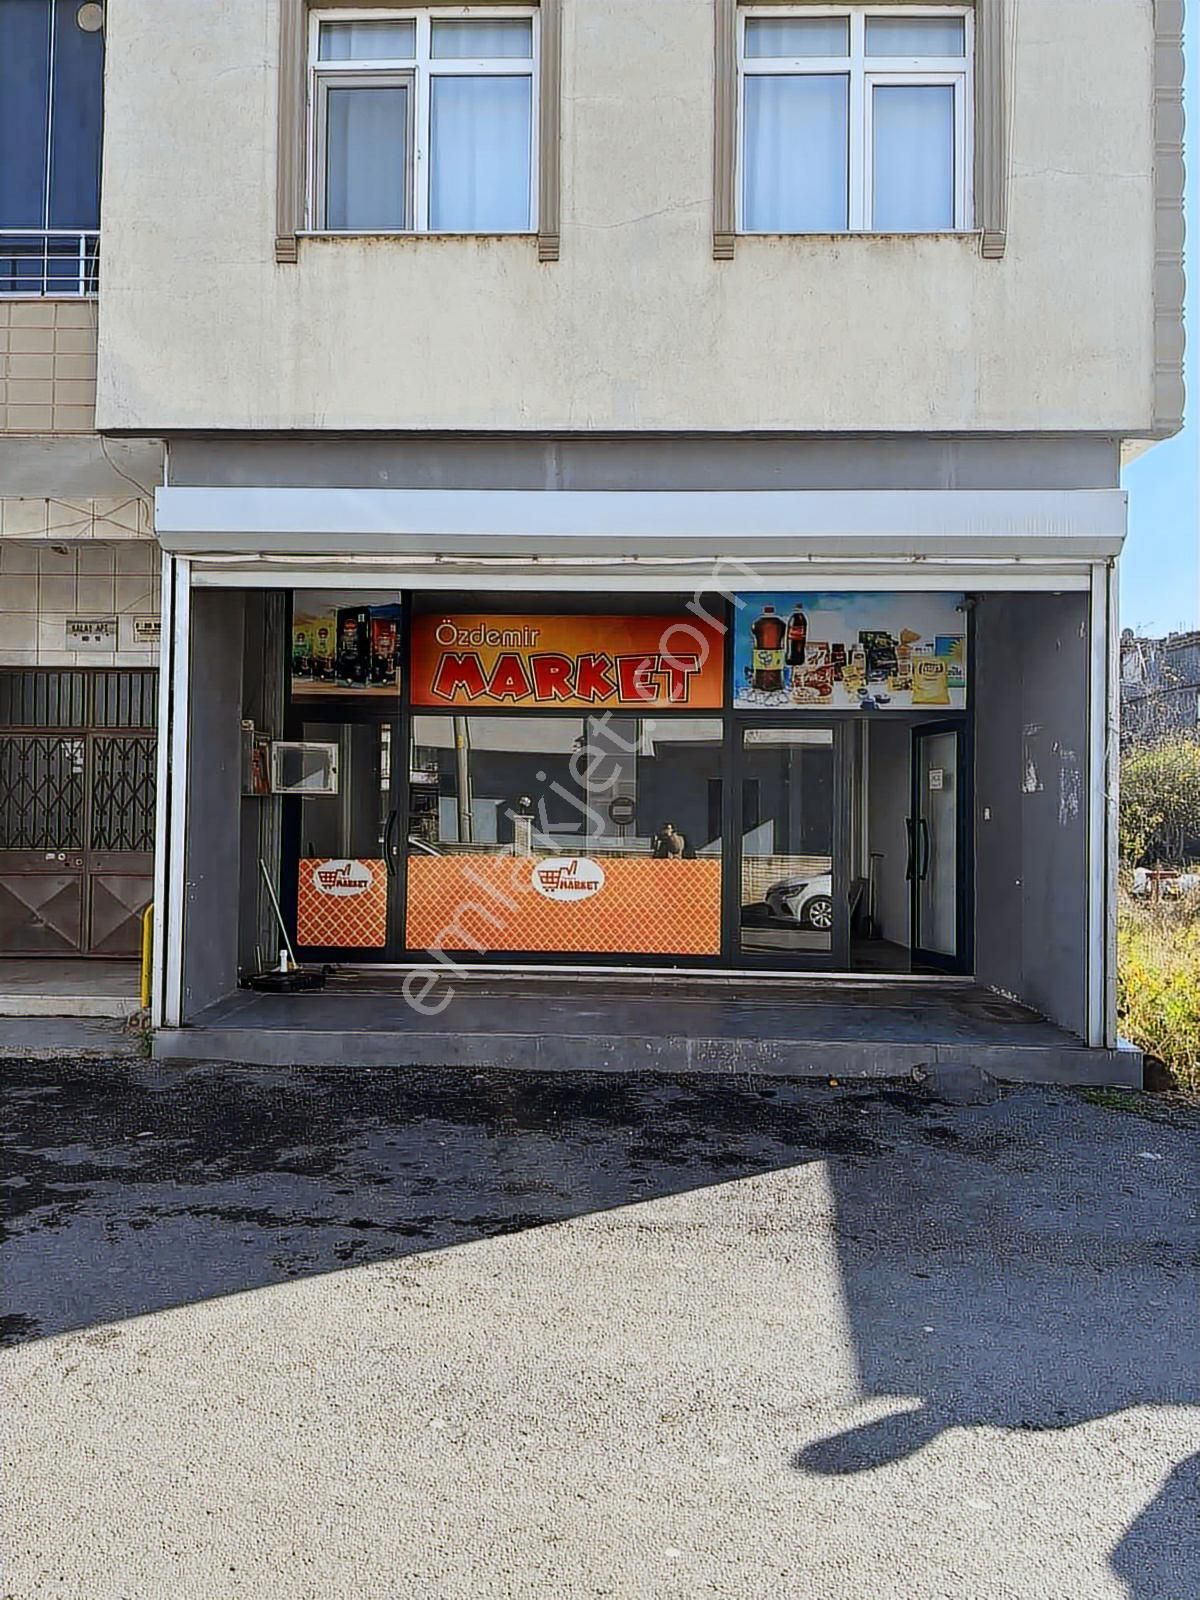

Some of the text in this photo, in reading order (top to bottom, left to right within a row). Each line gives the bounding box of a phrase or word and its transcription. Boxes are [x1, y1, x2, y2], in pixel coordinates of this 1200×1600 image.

[435, 619, 539, 647] Özdemir
[432, 652, 700, 703] MARKET
[560, 881, 599, 890] MARKET
